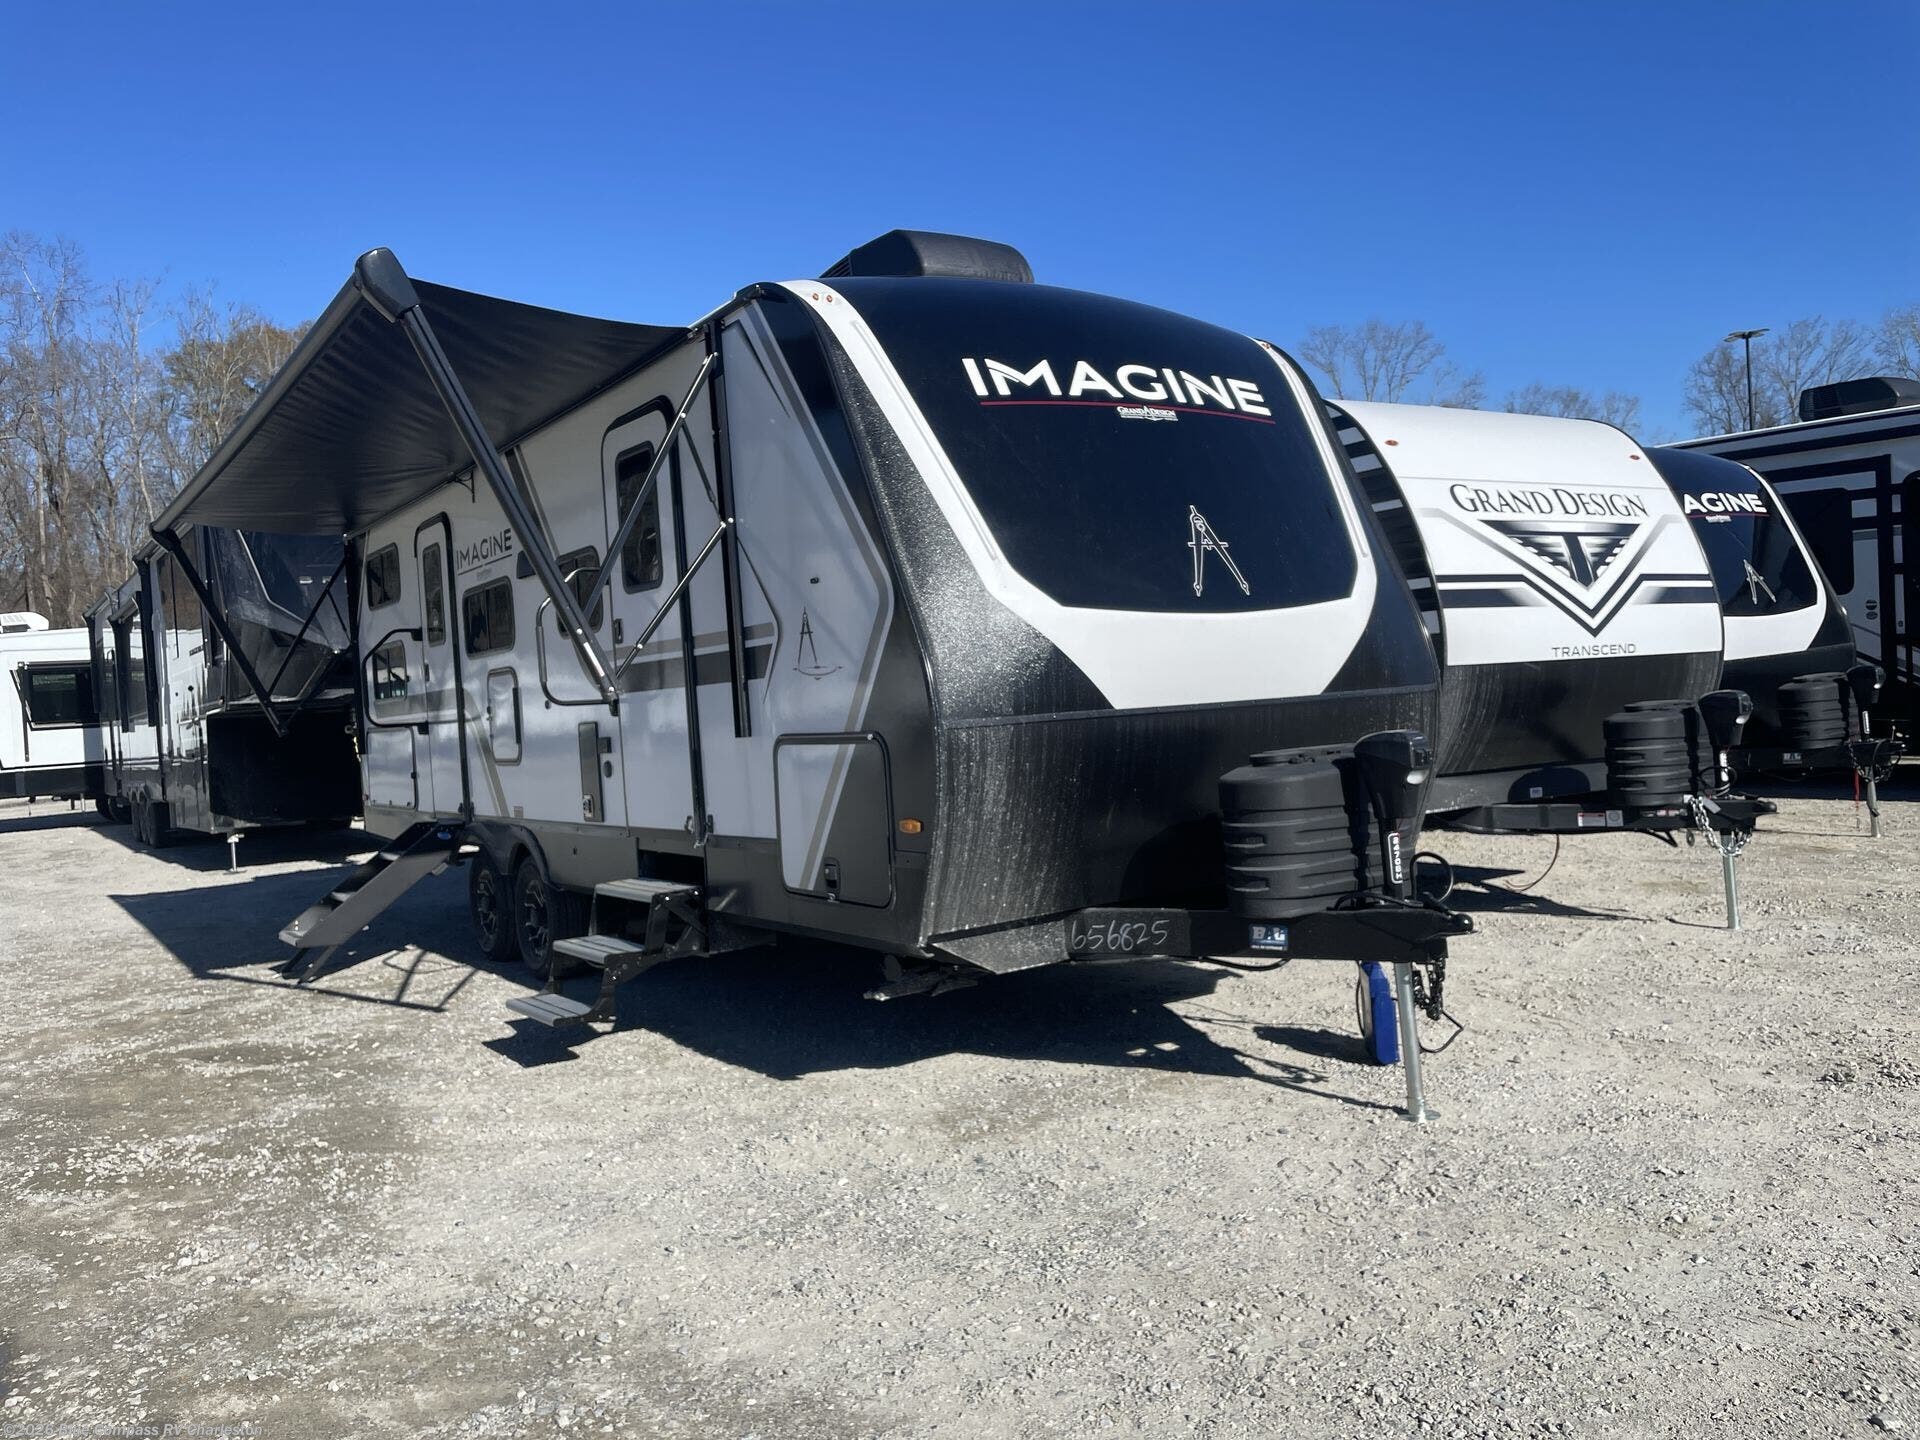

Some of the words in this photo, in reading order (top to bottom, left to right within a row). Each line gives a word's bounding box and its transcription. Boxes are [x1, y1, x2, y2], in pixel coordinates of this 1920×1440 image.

[961, 357, 1272, 416] IMAGINE
[1449, 483, 1554, 514] GRAND
[1549, 487, 1651, 517] DESIGN
[1683, 492, 1768, 514] AGINE
[456, 527, 513, 570] IMAGINE
[1551, 643, 1637, 657] TRANSCEND
[1071, 919, 1170, 951] 656825
